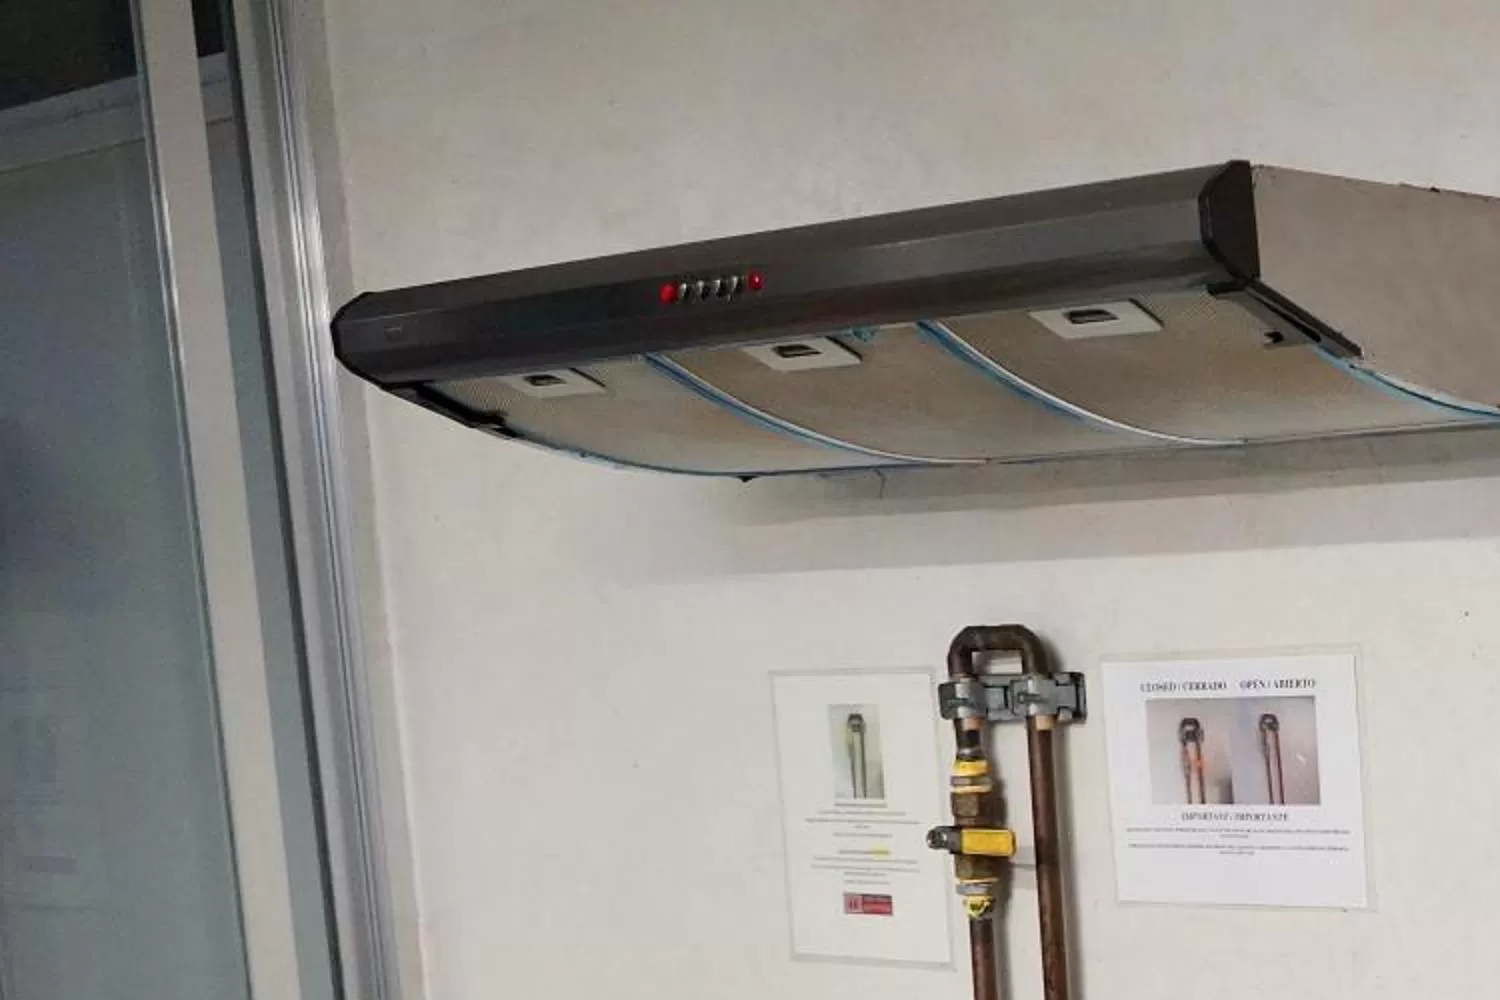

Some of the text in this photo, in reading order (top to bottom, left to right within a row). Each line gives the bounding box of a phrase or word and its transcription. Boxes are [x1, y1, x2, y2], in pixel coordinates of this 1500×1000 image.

[1182, 681, 1227, 691] CERRADO
[1239, 680, 1265, 690] OPEN
[1273, 679, 1317, 690] ABIERTO
